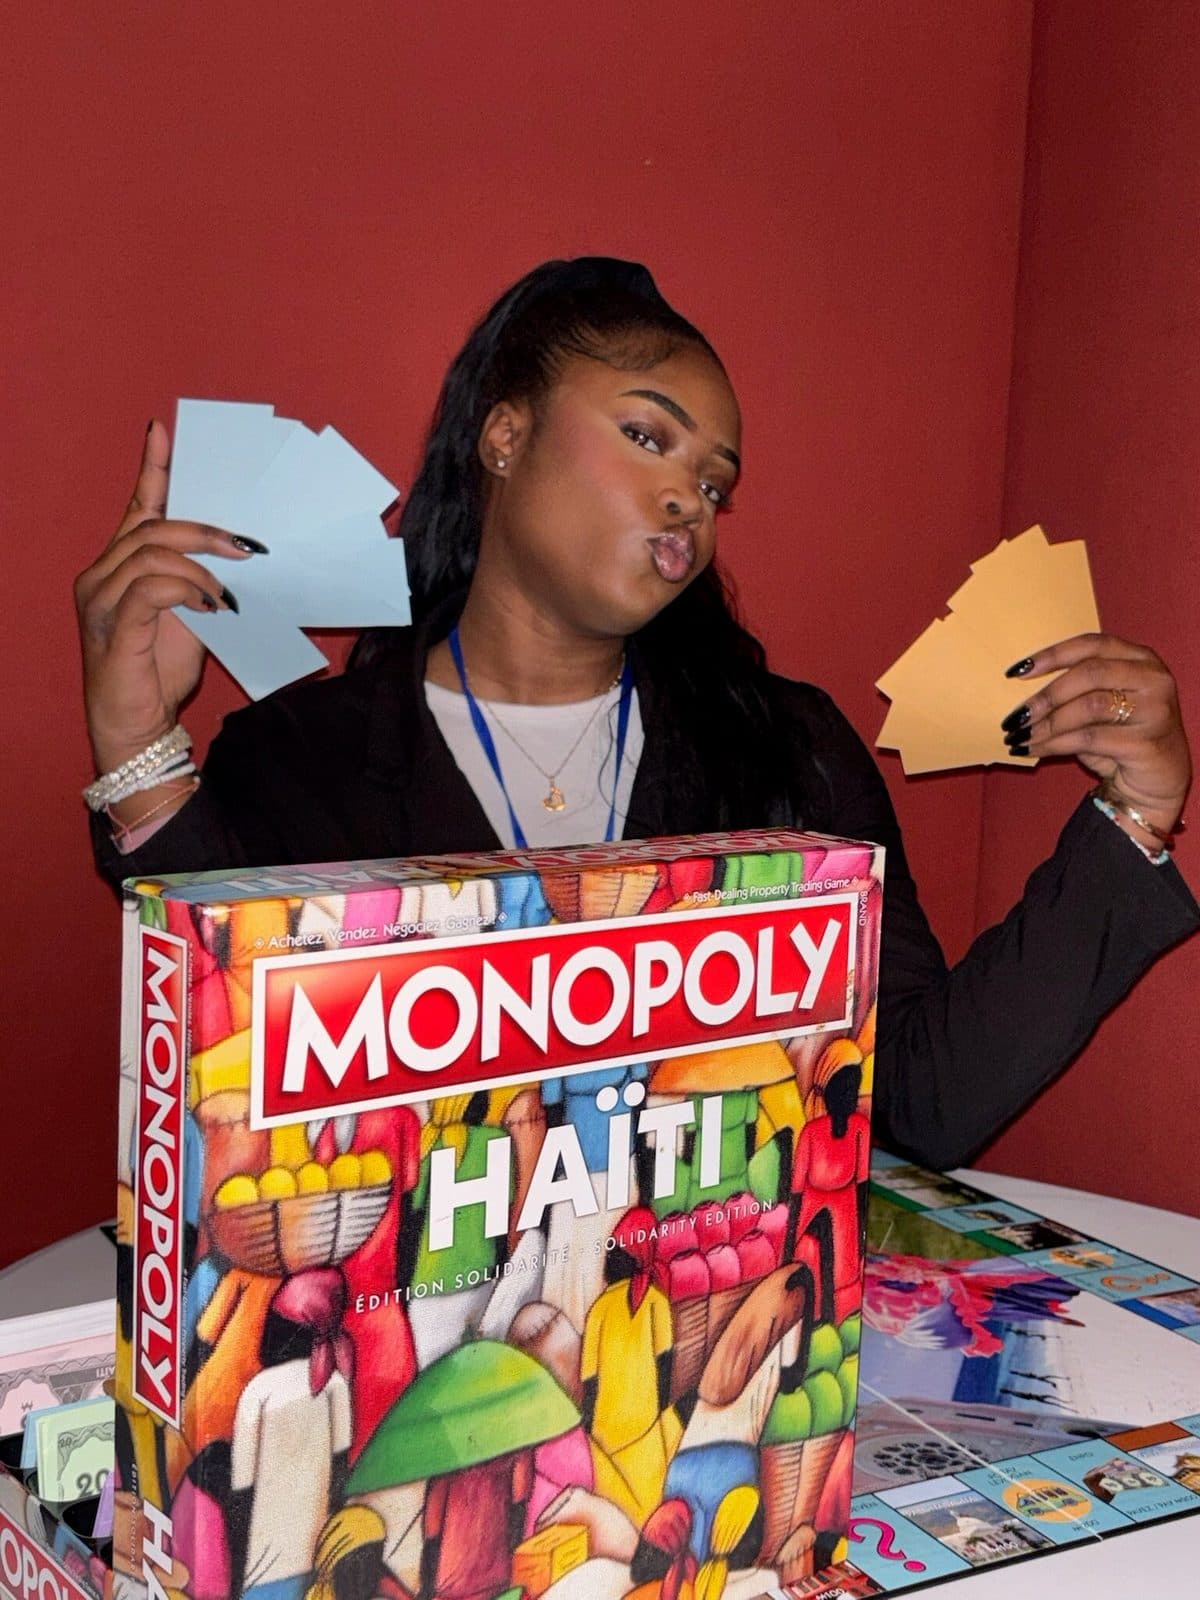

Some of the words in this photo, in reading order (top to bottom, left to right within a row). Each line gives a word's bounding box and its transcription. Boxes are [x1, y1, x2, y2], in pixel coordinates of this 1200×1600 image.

[693, 887, 748, 902] Fast-Dealing
[749, 883, 789, 897] Property
[790, 880, 823, 892] Trading
[824, 878, 850, 889] Game
[859, 890, 868, 926] BRAND
[281, 917, 842, 1093] MONOPOLY
[141, 947, 178, 1408] MONOPOLY
[427, 1081, 723, 1252] HAÏTI
[355, 1278, 443, 1314] ÉDITION
[455, 1242, 569, 1287] SOLIDARITÉ
[593, 1216, 697, 1255] SOLIDARITY
[705, 1199, 775, 1228] EDITION
